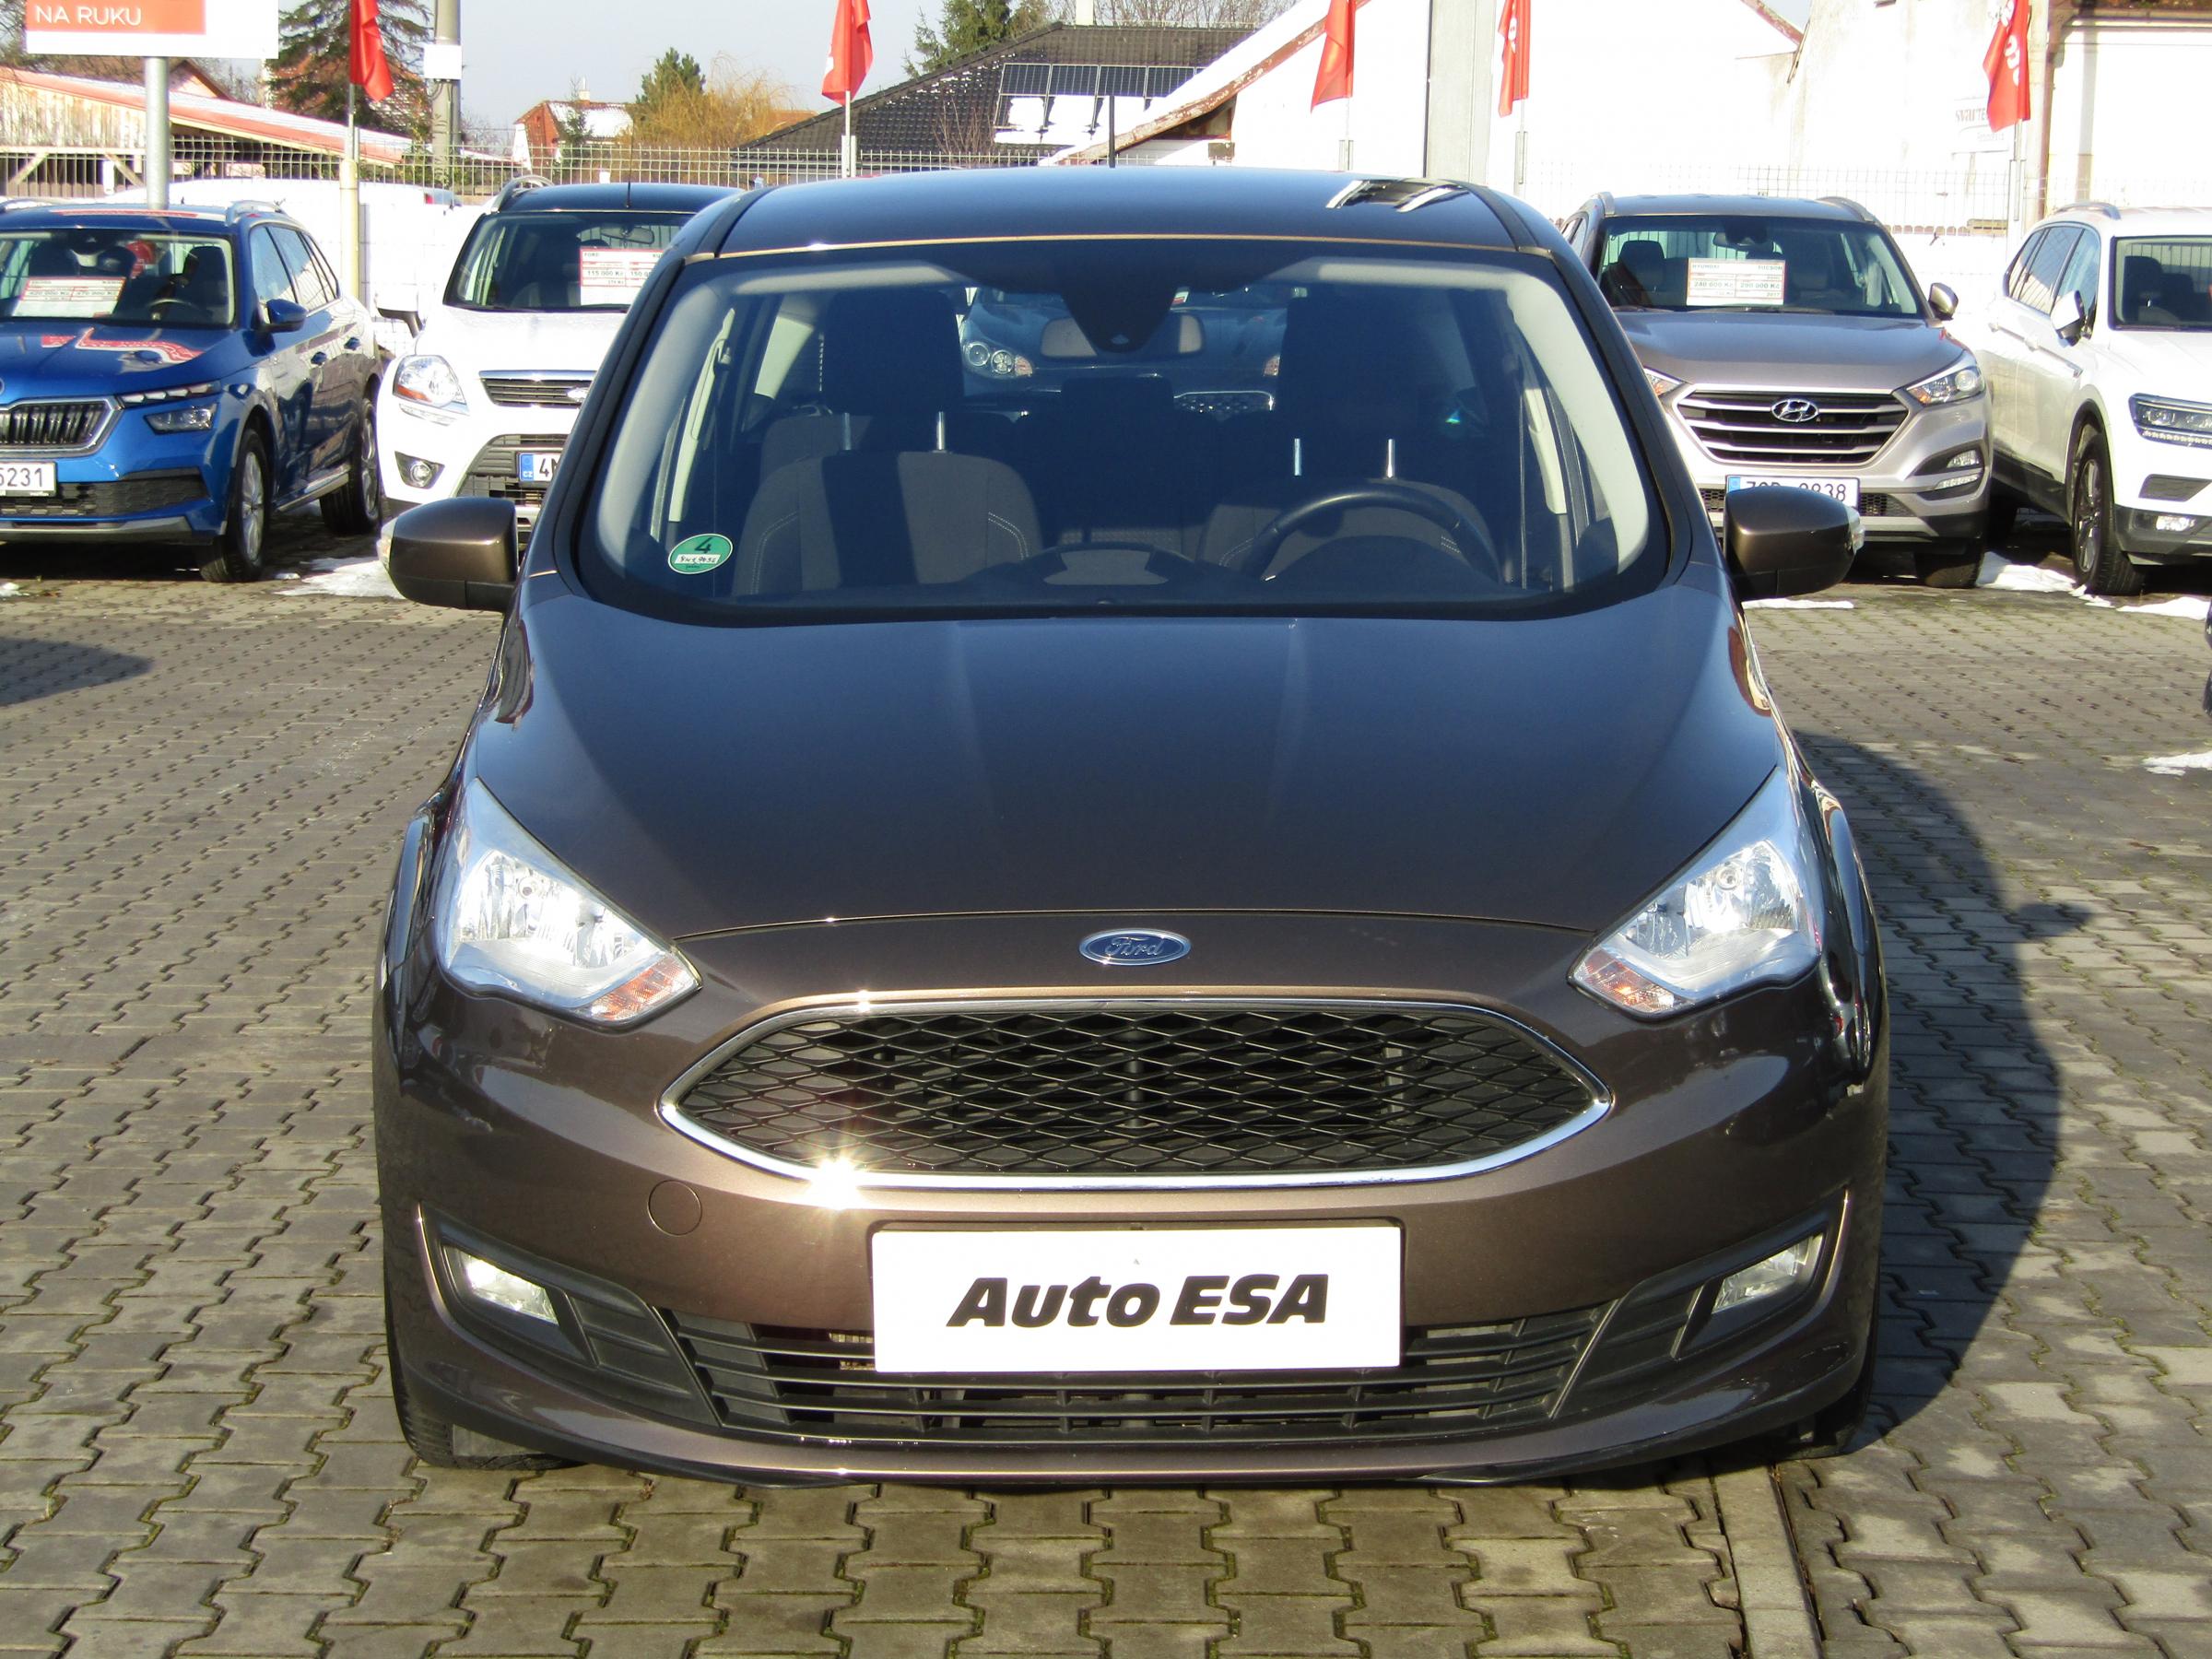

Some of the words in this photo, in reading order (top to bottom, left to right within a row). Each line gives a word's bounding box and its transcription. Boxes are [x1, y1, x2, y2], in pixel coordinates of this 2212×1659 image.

[35, 6, 70, 24] NA
[77, 6, 142, 26] RUKU
[694, 536, 712, 554] 4
[1105, 936, 1165, 957] Ford
[946, 1276, 1160, 1328] Auto
[1170, 1274, 1328, 1325] ESA
